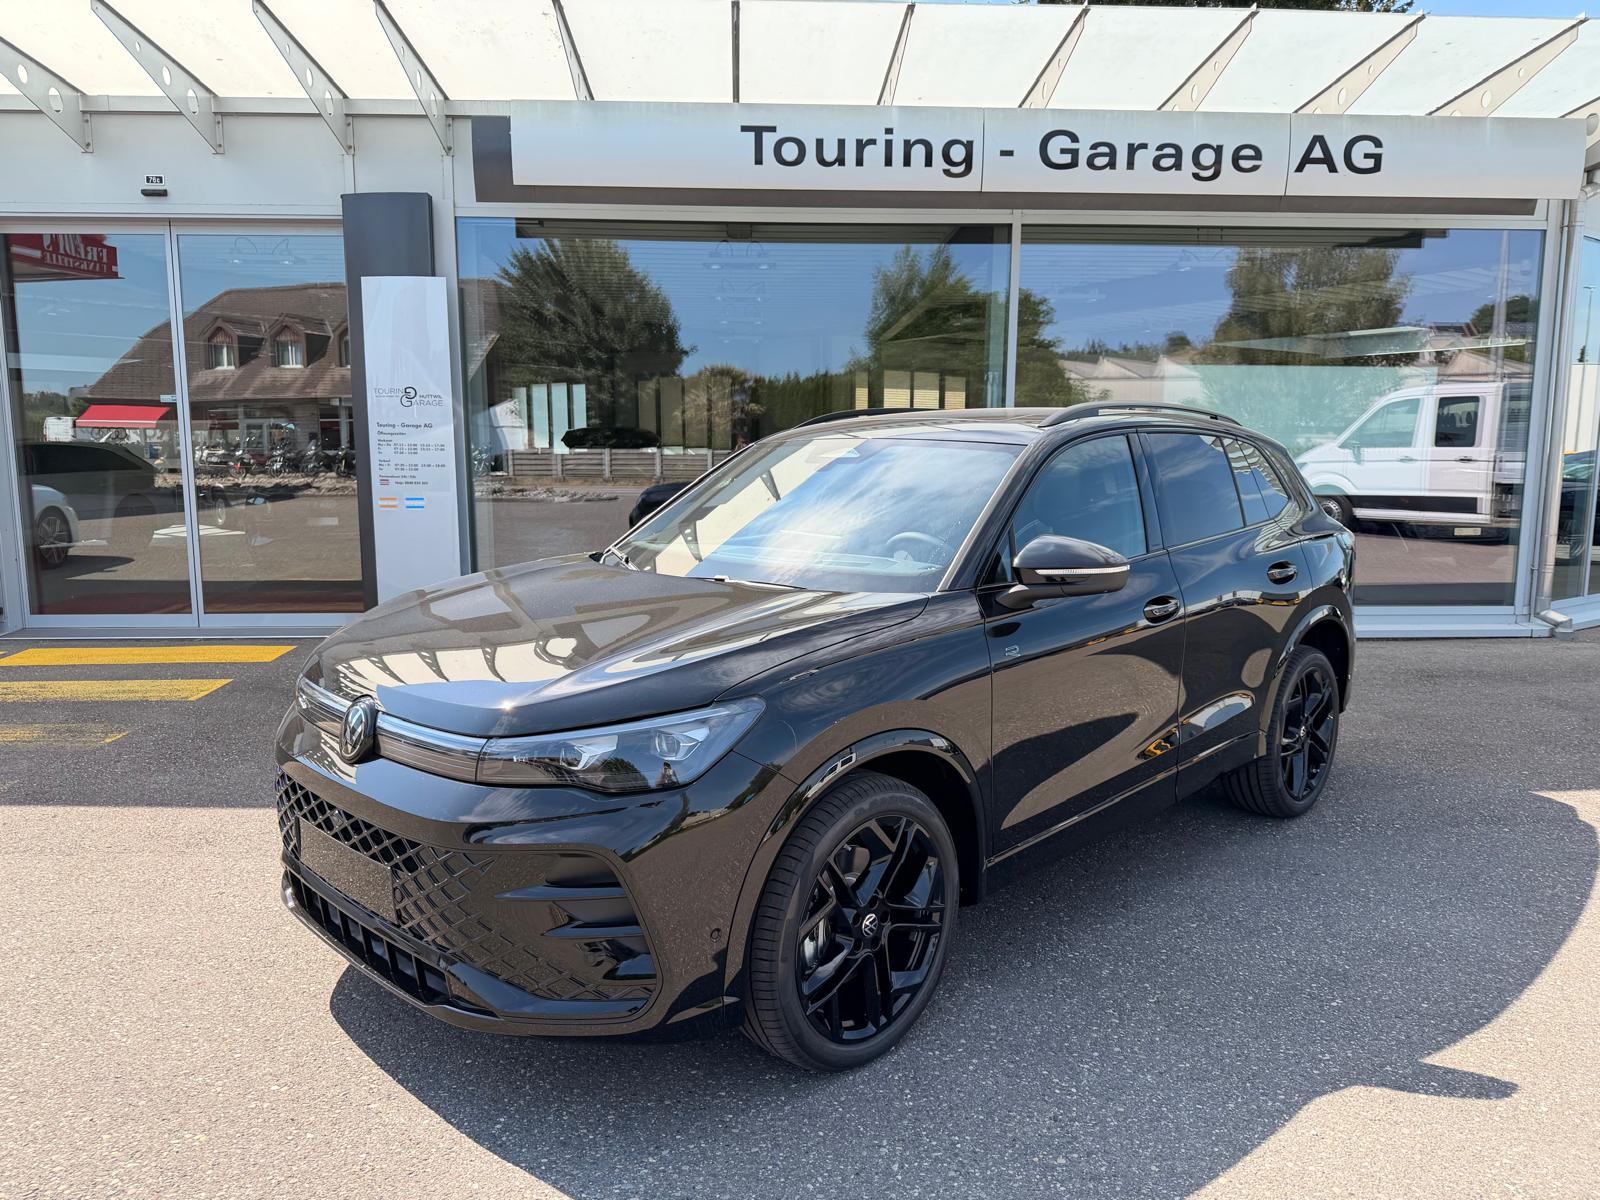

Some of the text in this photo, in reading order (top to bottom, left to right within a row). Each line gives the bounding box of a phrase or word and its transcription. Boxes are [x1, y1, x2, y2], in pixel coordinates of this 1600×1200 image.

[741, 126, 974, 179] Touring
[1040, 130, 1263, 182] Garage
[1295, 134, 1383, 175] AG
